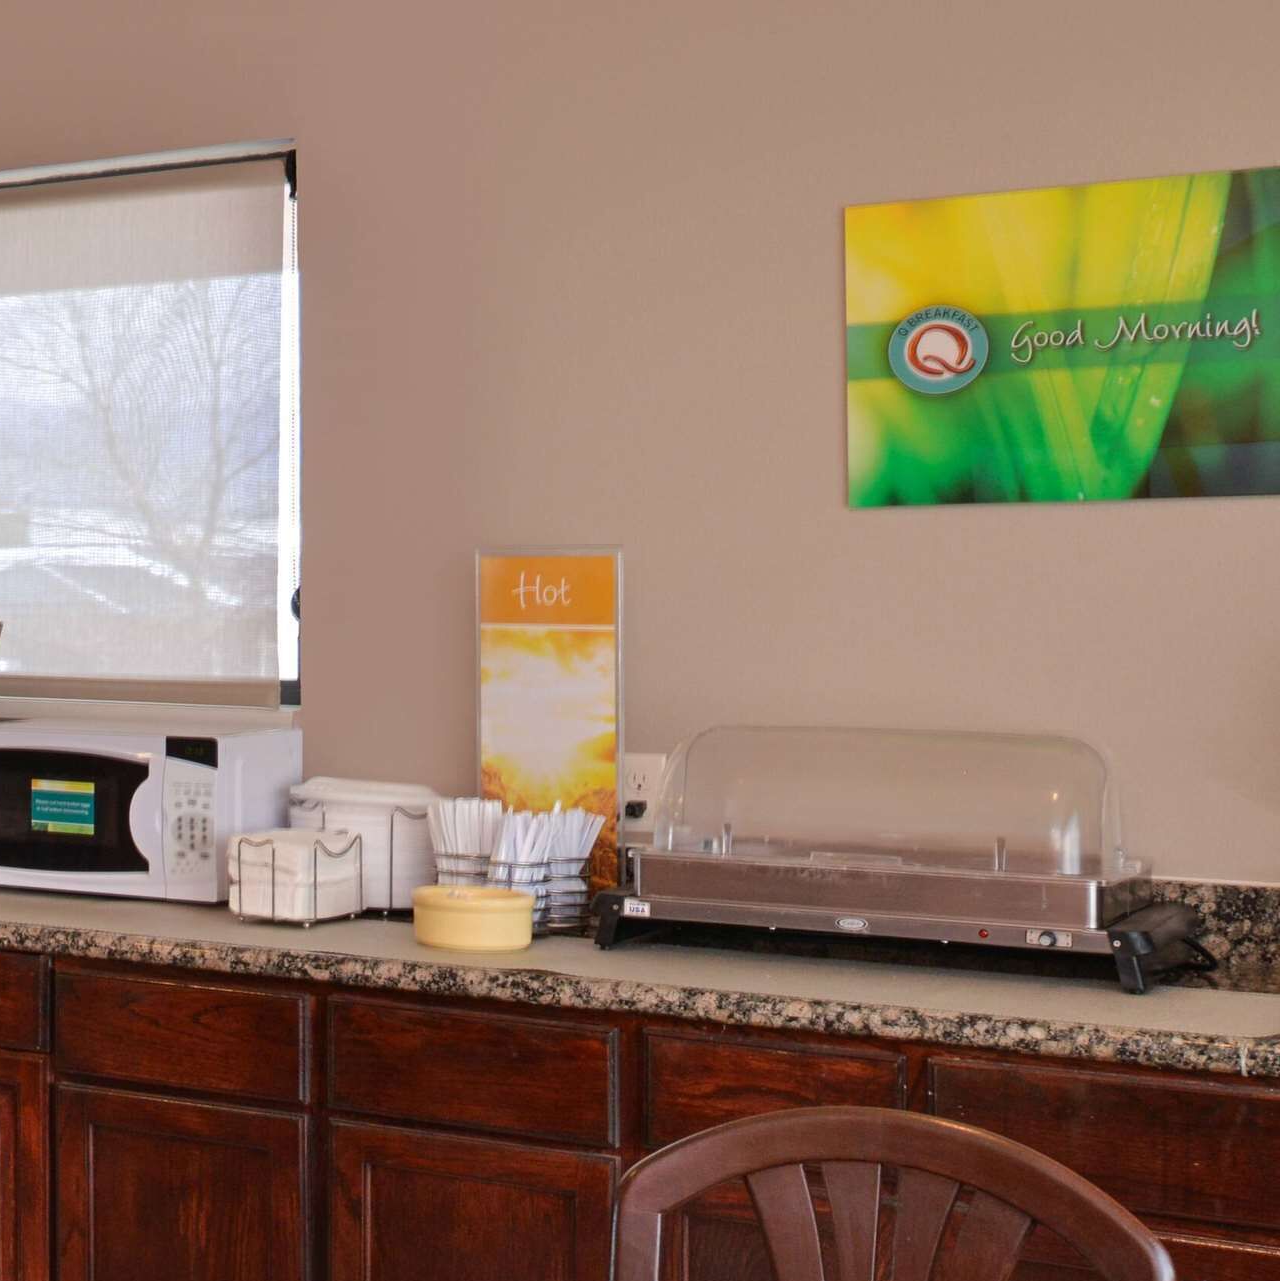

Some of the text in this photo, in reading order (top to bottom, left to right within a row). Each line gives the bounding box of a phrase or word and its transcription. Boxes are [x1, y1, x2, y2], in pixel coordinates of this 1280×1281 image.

[907, 307, 978, 332] BREAKFAST
[1011, 309, 1261, 363] Good Morning!
[512, 570, 572, 609] Hot
